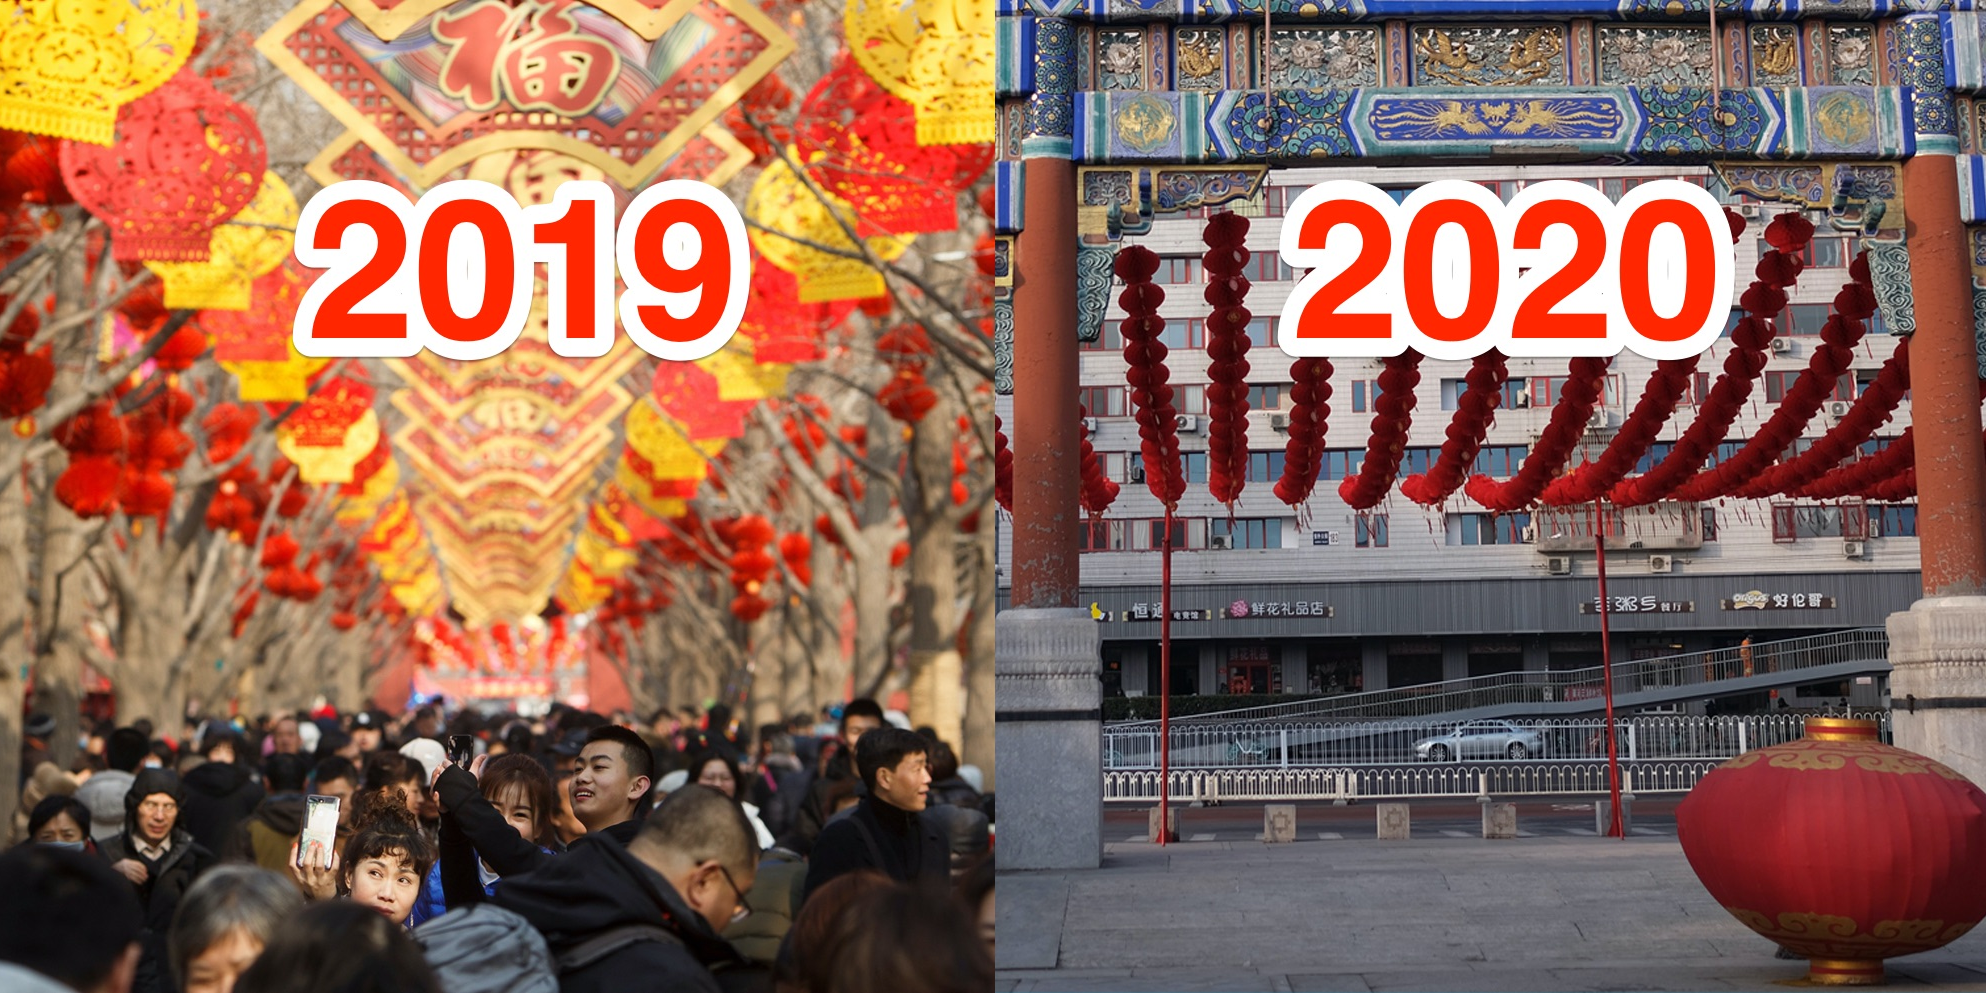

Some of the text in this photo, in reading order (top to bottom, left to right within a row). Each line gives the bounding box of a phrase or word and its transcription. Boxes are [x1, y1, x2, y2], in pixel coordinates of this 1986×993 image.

[431, 0, 621, 117] 福
[1773, 593, 1823, 608] 好伦哥
[1251, 601, 1324, 616] 鲜花礼品店
